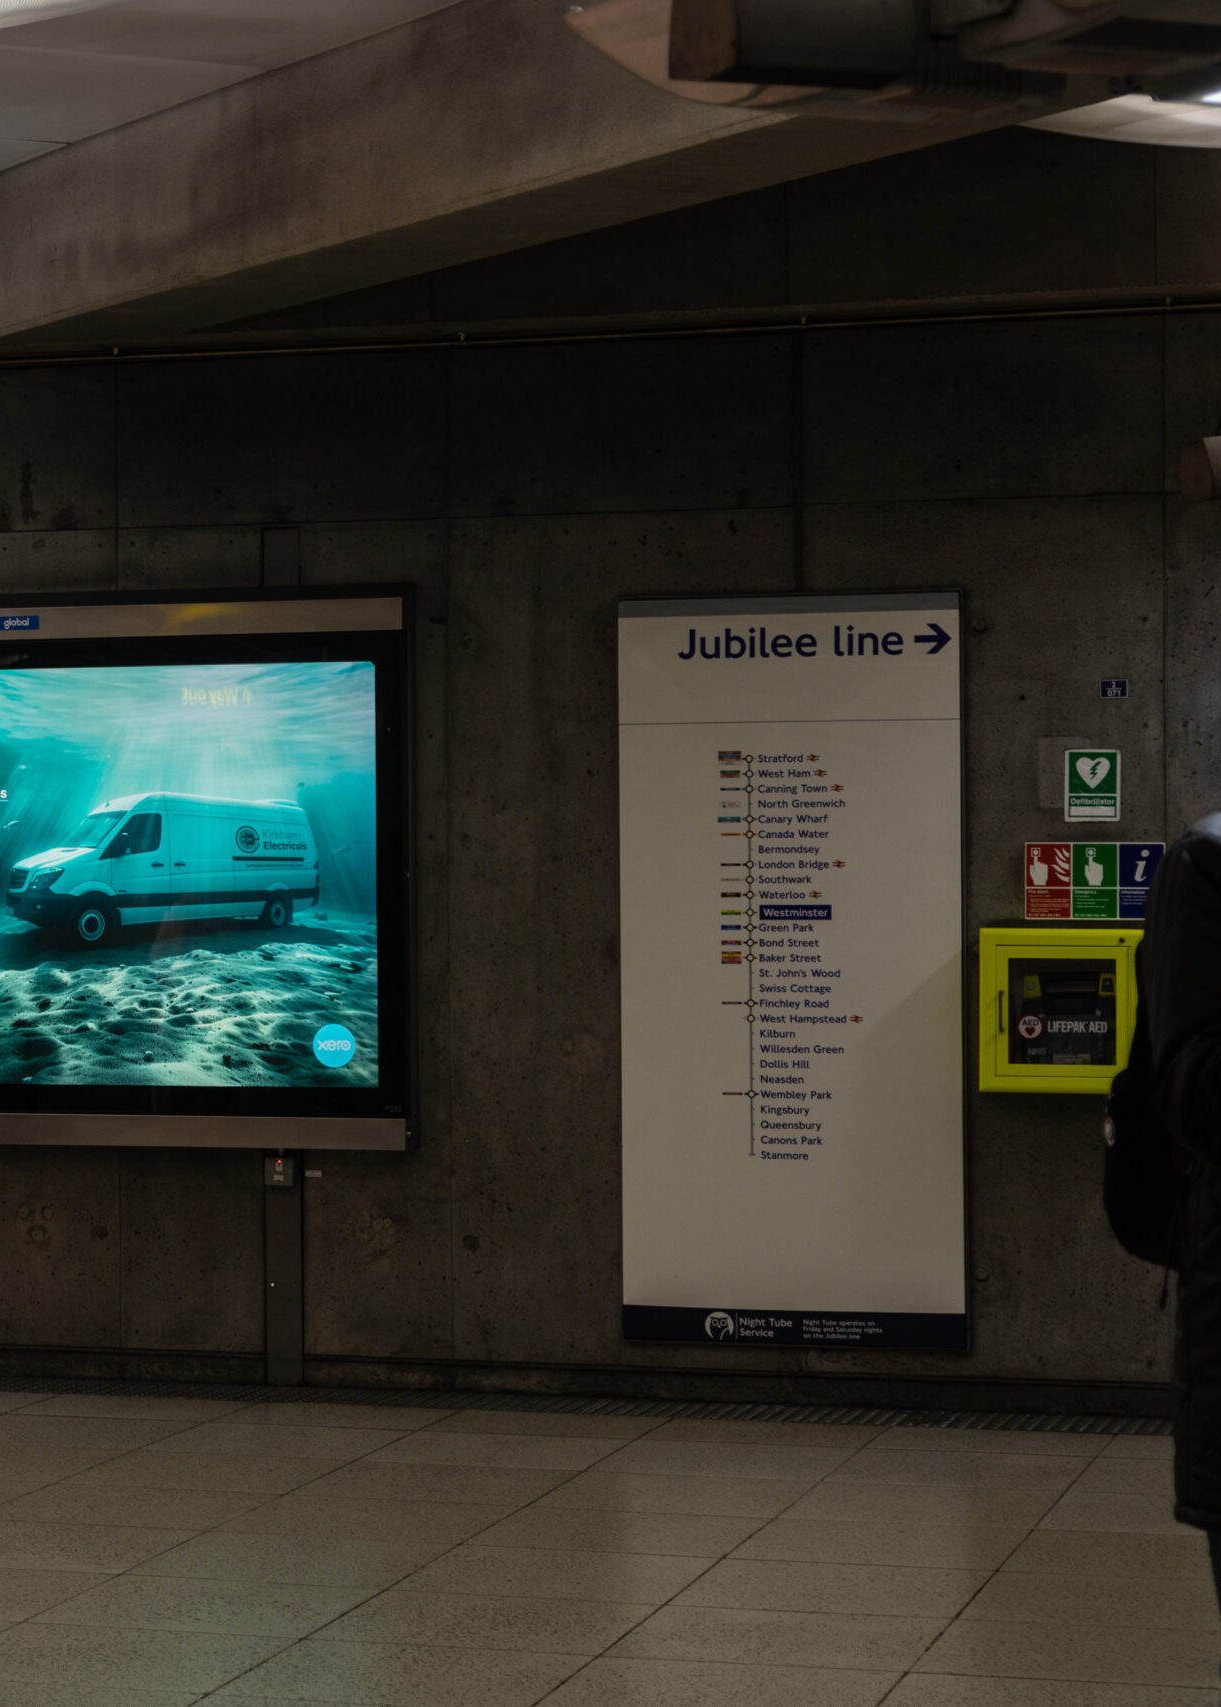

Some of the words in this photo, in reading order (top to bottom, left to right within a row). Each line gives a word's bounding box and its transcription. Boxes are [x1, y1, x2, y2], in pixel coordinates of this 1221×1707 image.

[4, 618, 30, 630] global
[678, 627, 817, 660] Jubilee
[834, 625, 903, 656] line
[758, 754, 803, 763] Stratford
[758, 770, 784, 778] West
[758, 785, 797, 795] Canning
[801, 784, 827, 792] Town
[758, 800, 788, 808] North
[792, 800, 845, 808] Greenwich
[1070, 797, 1116, 805] Defibrillator
[758, 815, 792, 825] Canary
[796, 814, 828, 823] Wharf
[758, 830, 794, 839] Canada
[798, 830, 829, 838] Water
[264, 841, 308, 850] Electricals
[758, 845, 819, 855] Bermondsey
[759, 860, 795, 869] London
[799, 860, 829, 870] Bridge
[759, 875, 811, 884] Southwark
[759, 891, 805, 899] Waterloo
[763, 908, 828, 918] Westminster
[758, 924, 789, 932] Green
[793, 923, 813, 932] Park
[759, 939, 784, 947] Bond
[788, 939, 819, 947] Street
[759, 954, 786, 962] Baker
[790, 954, 821, 962] Street
[759, 969, 772, 977] St.
[776, 969, 807, 977] John's
[811, 969, 840, 977] Wood
[759, 984, 787, 992] Swiss
[790, 984, 831, 995] Cottage
[760, 999, 800, 1010] Finchley
[804, 999, 829, 1008] Road
[760, 1014, 786, 1023] West
[790, 1015, 846, 1024] Hampstead
[1048, 1020, 1086, 1033] LIFEPAK
[1088, 1021, 1108, 1033] AED
[760, 1030, 795, 1038] Kilburn
[317, 1040, 351, 1051] xero
[760, 1045, 810, 1053] Willesden
[814, 1045, 844, 1054] Green
[760, 1060, 788, 1068] Dollis
[792, 1060, 809, 1068] Hill
[761, 1075, 804, 1084] Neasden
[760, 1090, 806, 1101] Wembley
[811, 1091, 831, 1099] Park
[761, 1105, 809, 1116] Kingsbury
[760, 1120, 821, 1131] Queensbury
[761, 1135, 797, 1144] Canons
[801, 1136, 822, 1145] Park
[761, 1151, 808, 1160] Stanmore
[739, 1318, 766, 1328] Night
[768, 1318, 792, 1327] Tube
[803, 1319, 820, 1327] Night
[740, 1329, 774, 1338] Service
